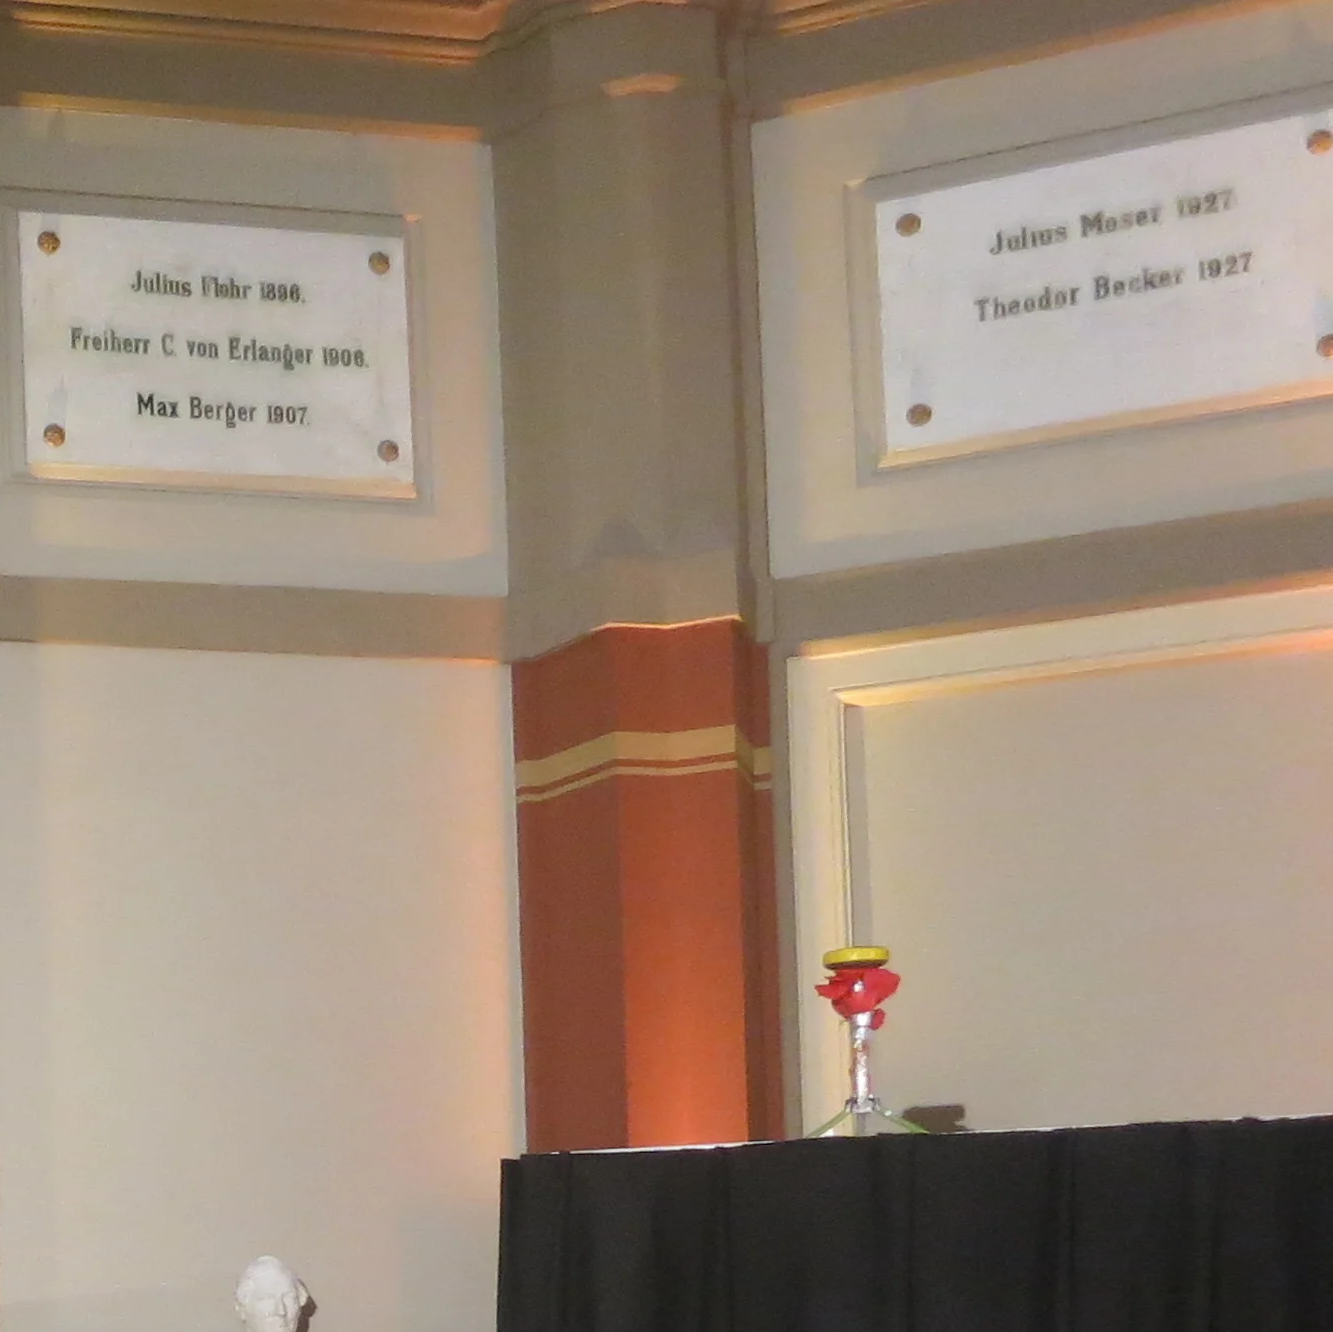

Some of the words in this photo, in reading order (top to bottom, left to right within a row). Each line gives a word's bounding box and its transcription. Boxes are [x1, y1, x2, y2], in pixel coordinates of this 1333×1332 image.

[989, 225, 1069, 256] Julius
[130, 269, 193, 298] Julius
[973, 284, 1081, 322] Theodor
[1093, 266, 1185, 301] Becker
[1198, 250, 1253, 281] 1927
[69, 326, 151, 355] Freiherr
[186, 339, 219, 359] von
[228, 335, 314, 371] Erlanger
[136, 391, 180, 418] Max
[189, 395, 257, 429] Berger
